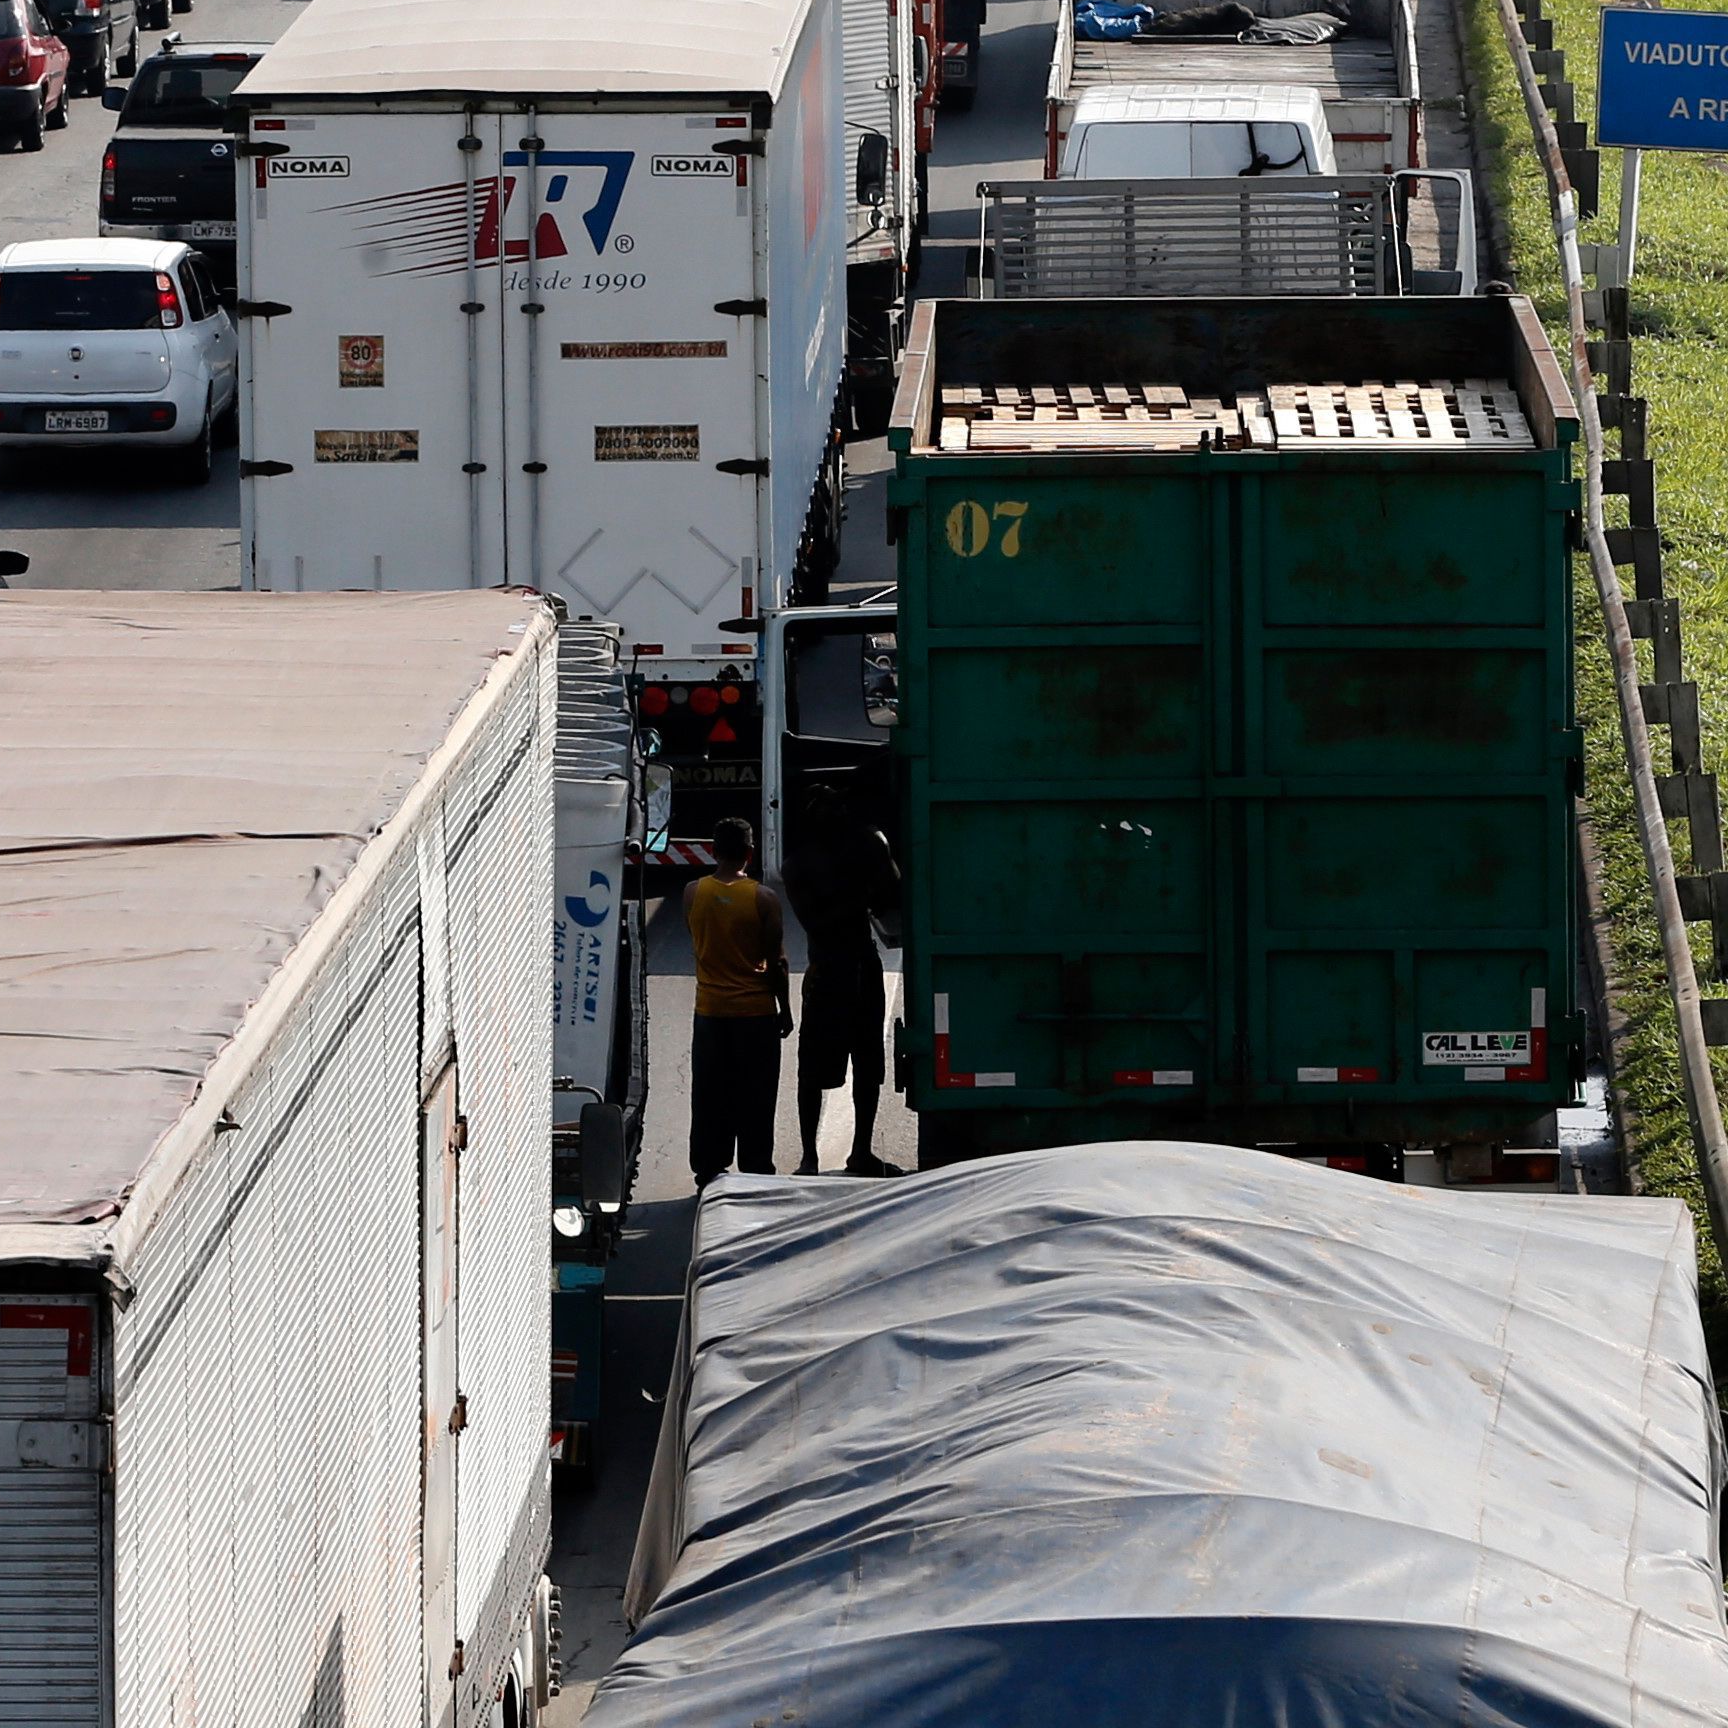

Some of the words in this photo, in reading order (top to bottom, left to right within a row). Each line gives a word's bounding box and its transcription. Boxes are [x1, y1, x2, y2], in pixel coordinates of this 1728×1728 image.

[1668, 96, 1691, 120] A
[271, 159, 346, 174] NOMA
[656, 158, 729, 173] NOMA
[581, 272, 646, 293] 1990
[350, 345, 371, 360] 80
[945, 500, 1029, 557] 07
[1425, 1035, 1467, 1051] CAL
[1470, 1035, 1527, 1051] LEVE
